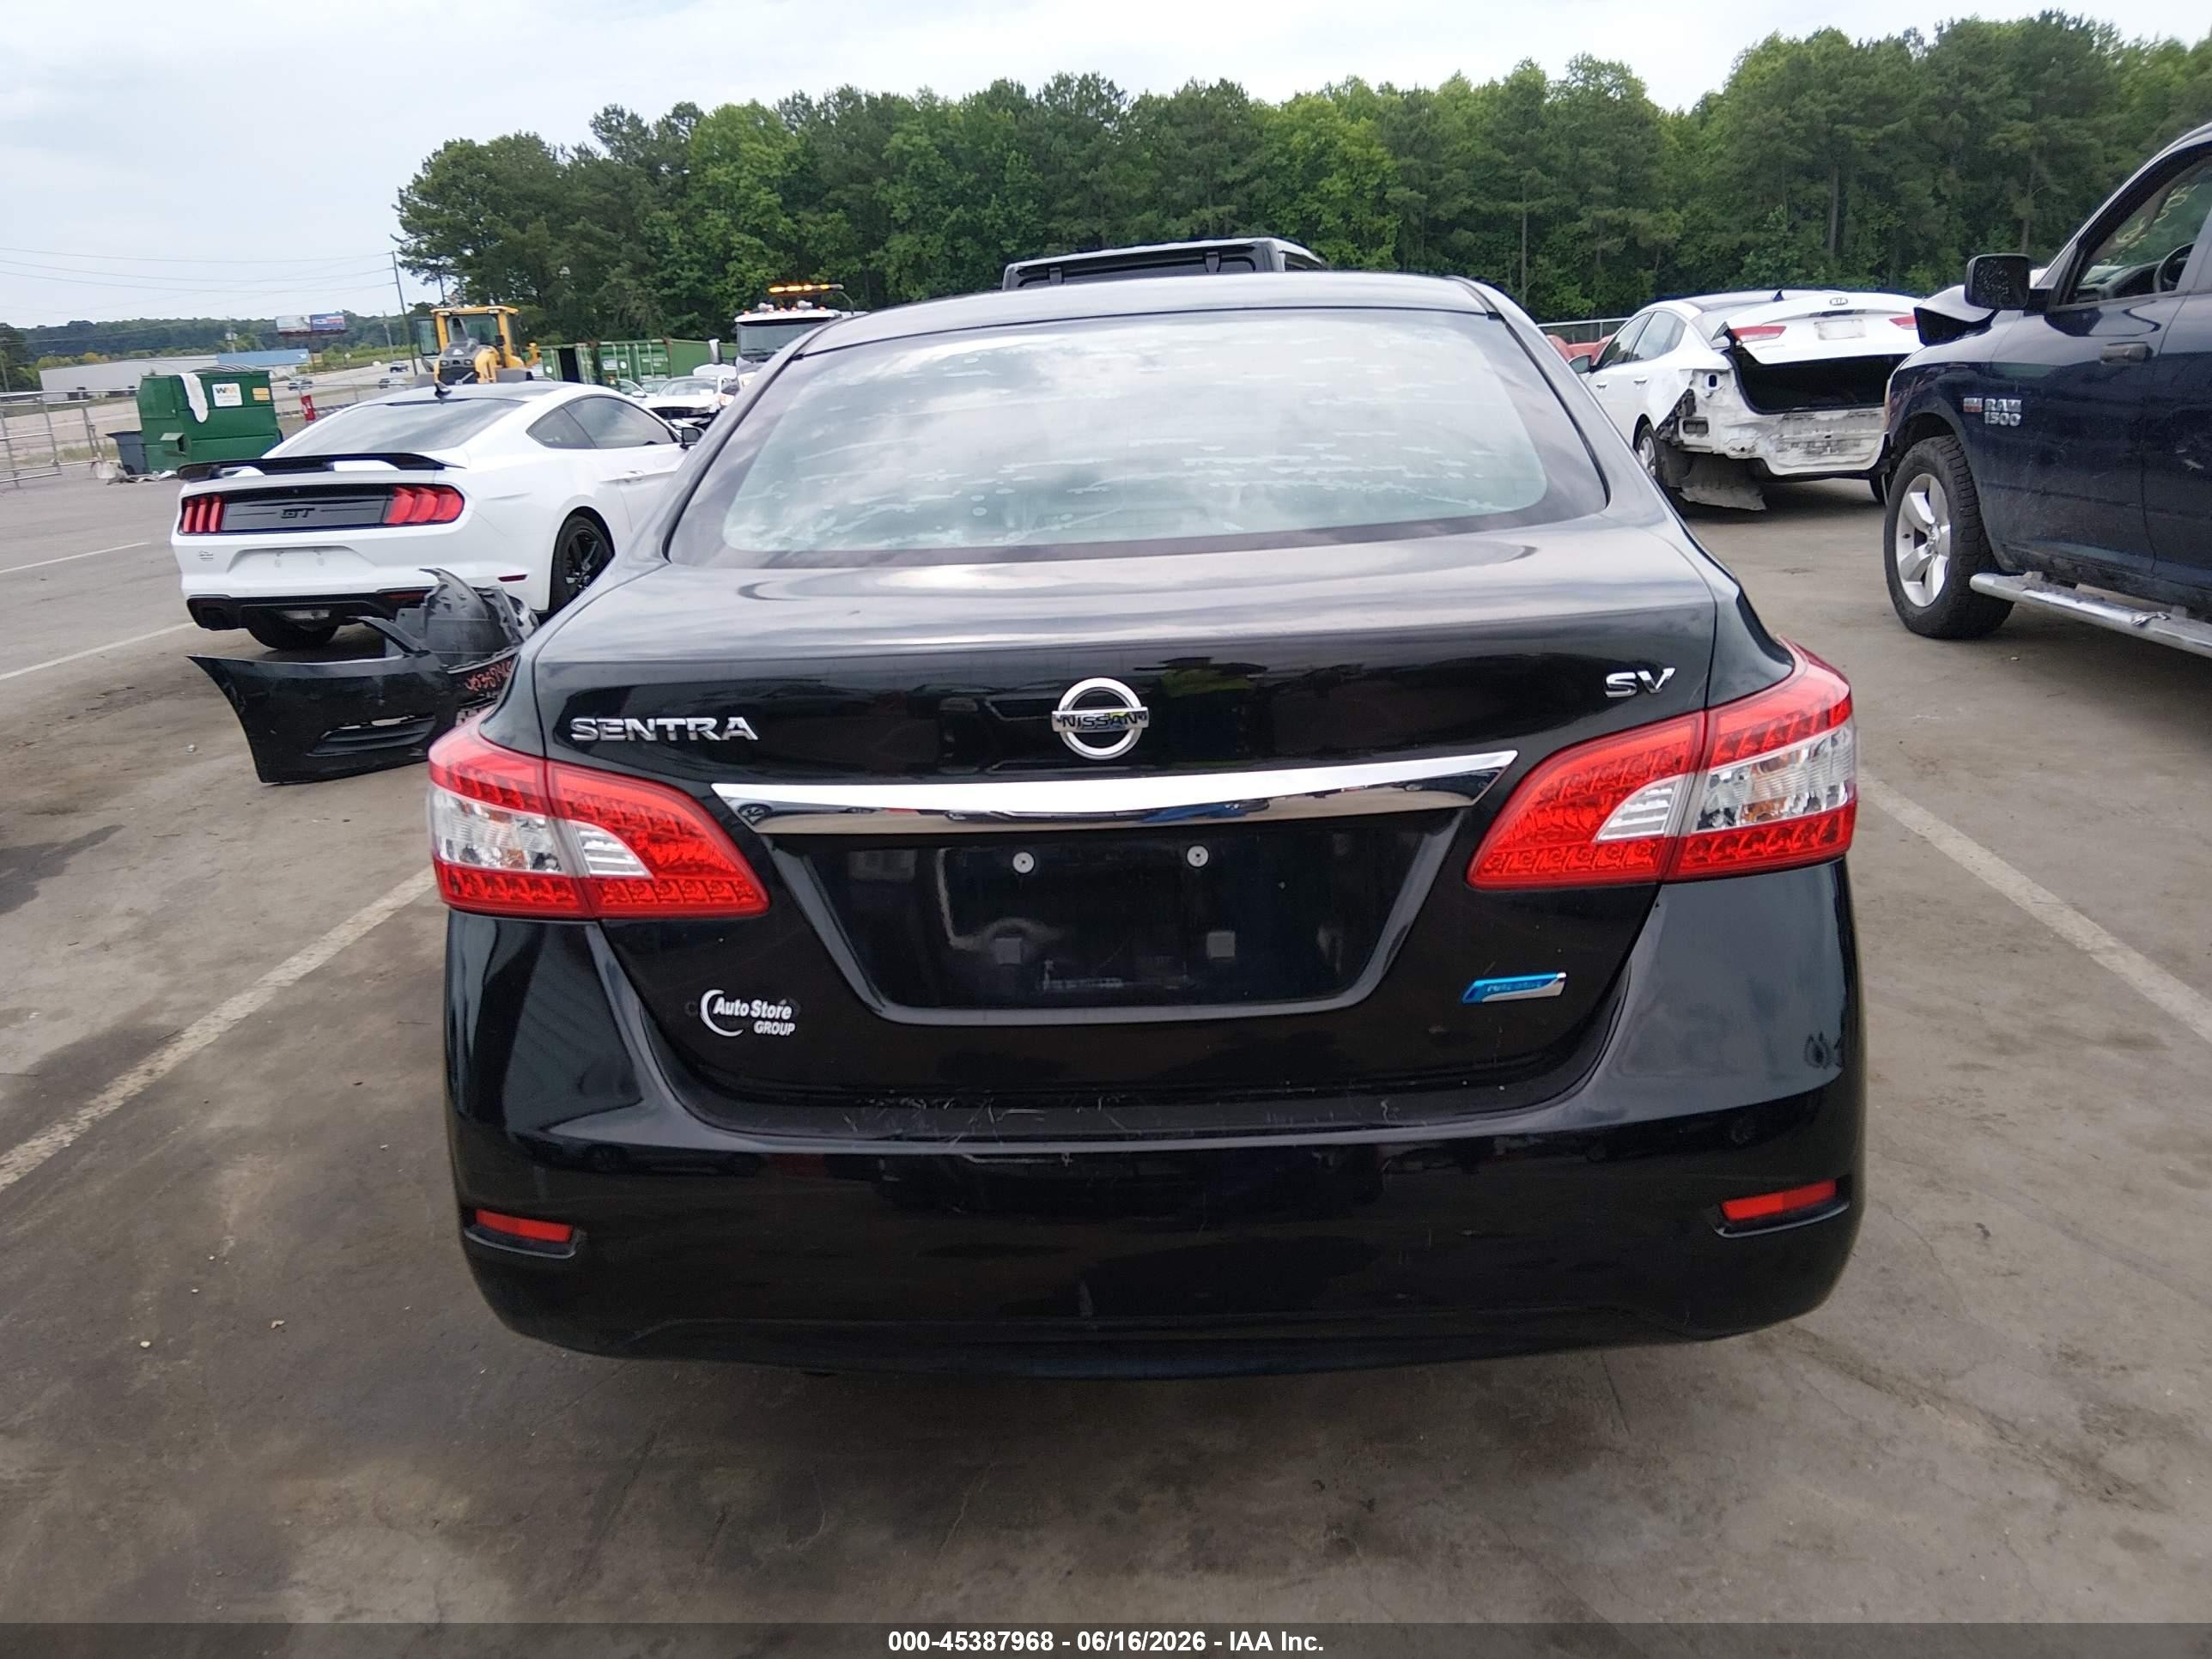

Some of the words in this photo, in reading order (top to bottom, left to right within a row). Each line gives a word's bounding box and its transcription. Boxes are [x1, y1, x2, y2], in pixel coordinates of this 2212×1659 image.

[1984, 398, 2022, 412] RAM
[1984, 411, 2021, 426] 1500
[281, 507, 315, 519] GT
[1605, 667, 1676, 697] SV
[1060, 712, 1139, 728] NISSAN
[570, 716, 758, 741] SENTRA
[713, 996, 750, 1017] Auto
[750, 999, 793, 1020] Store
[753, 1020, 796, 1036] GROUP
